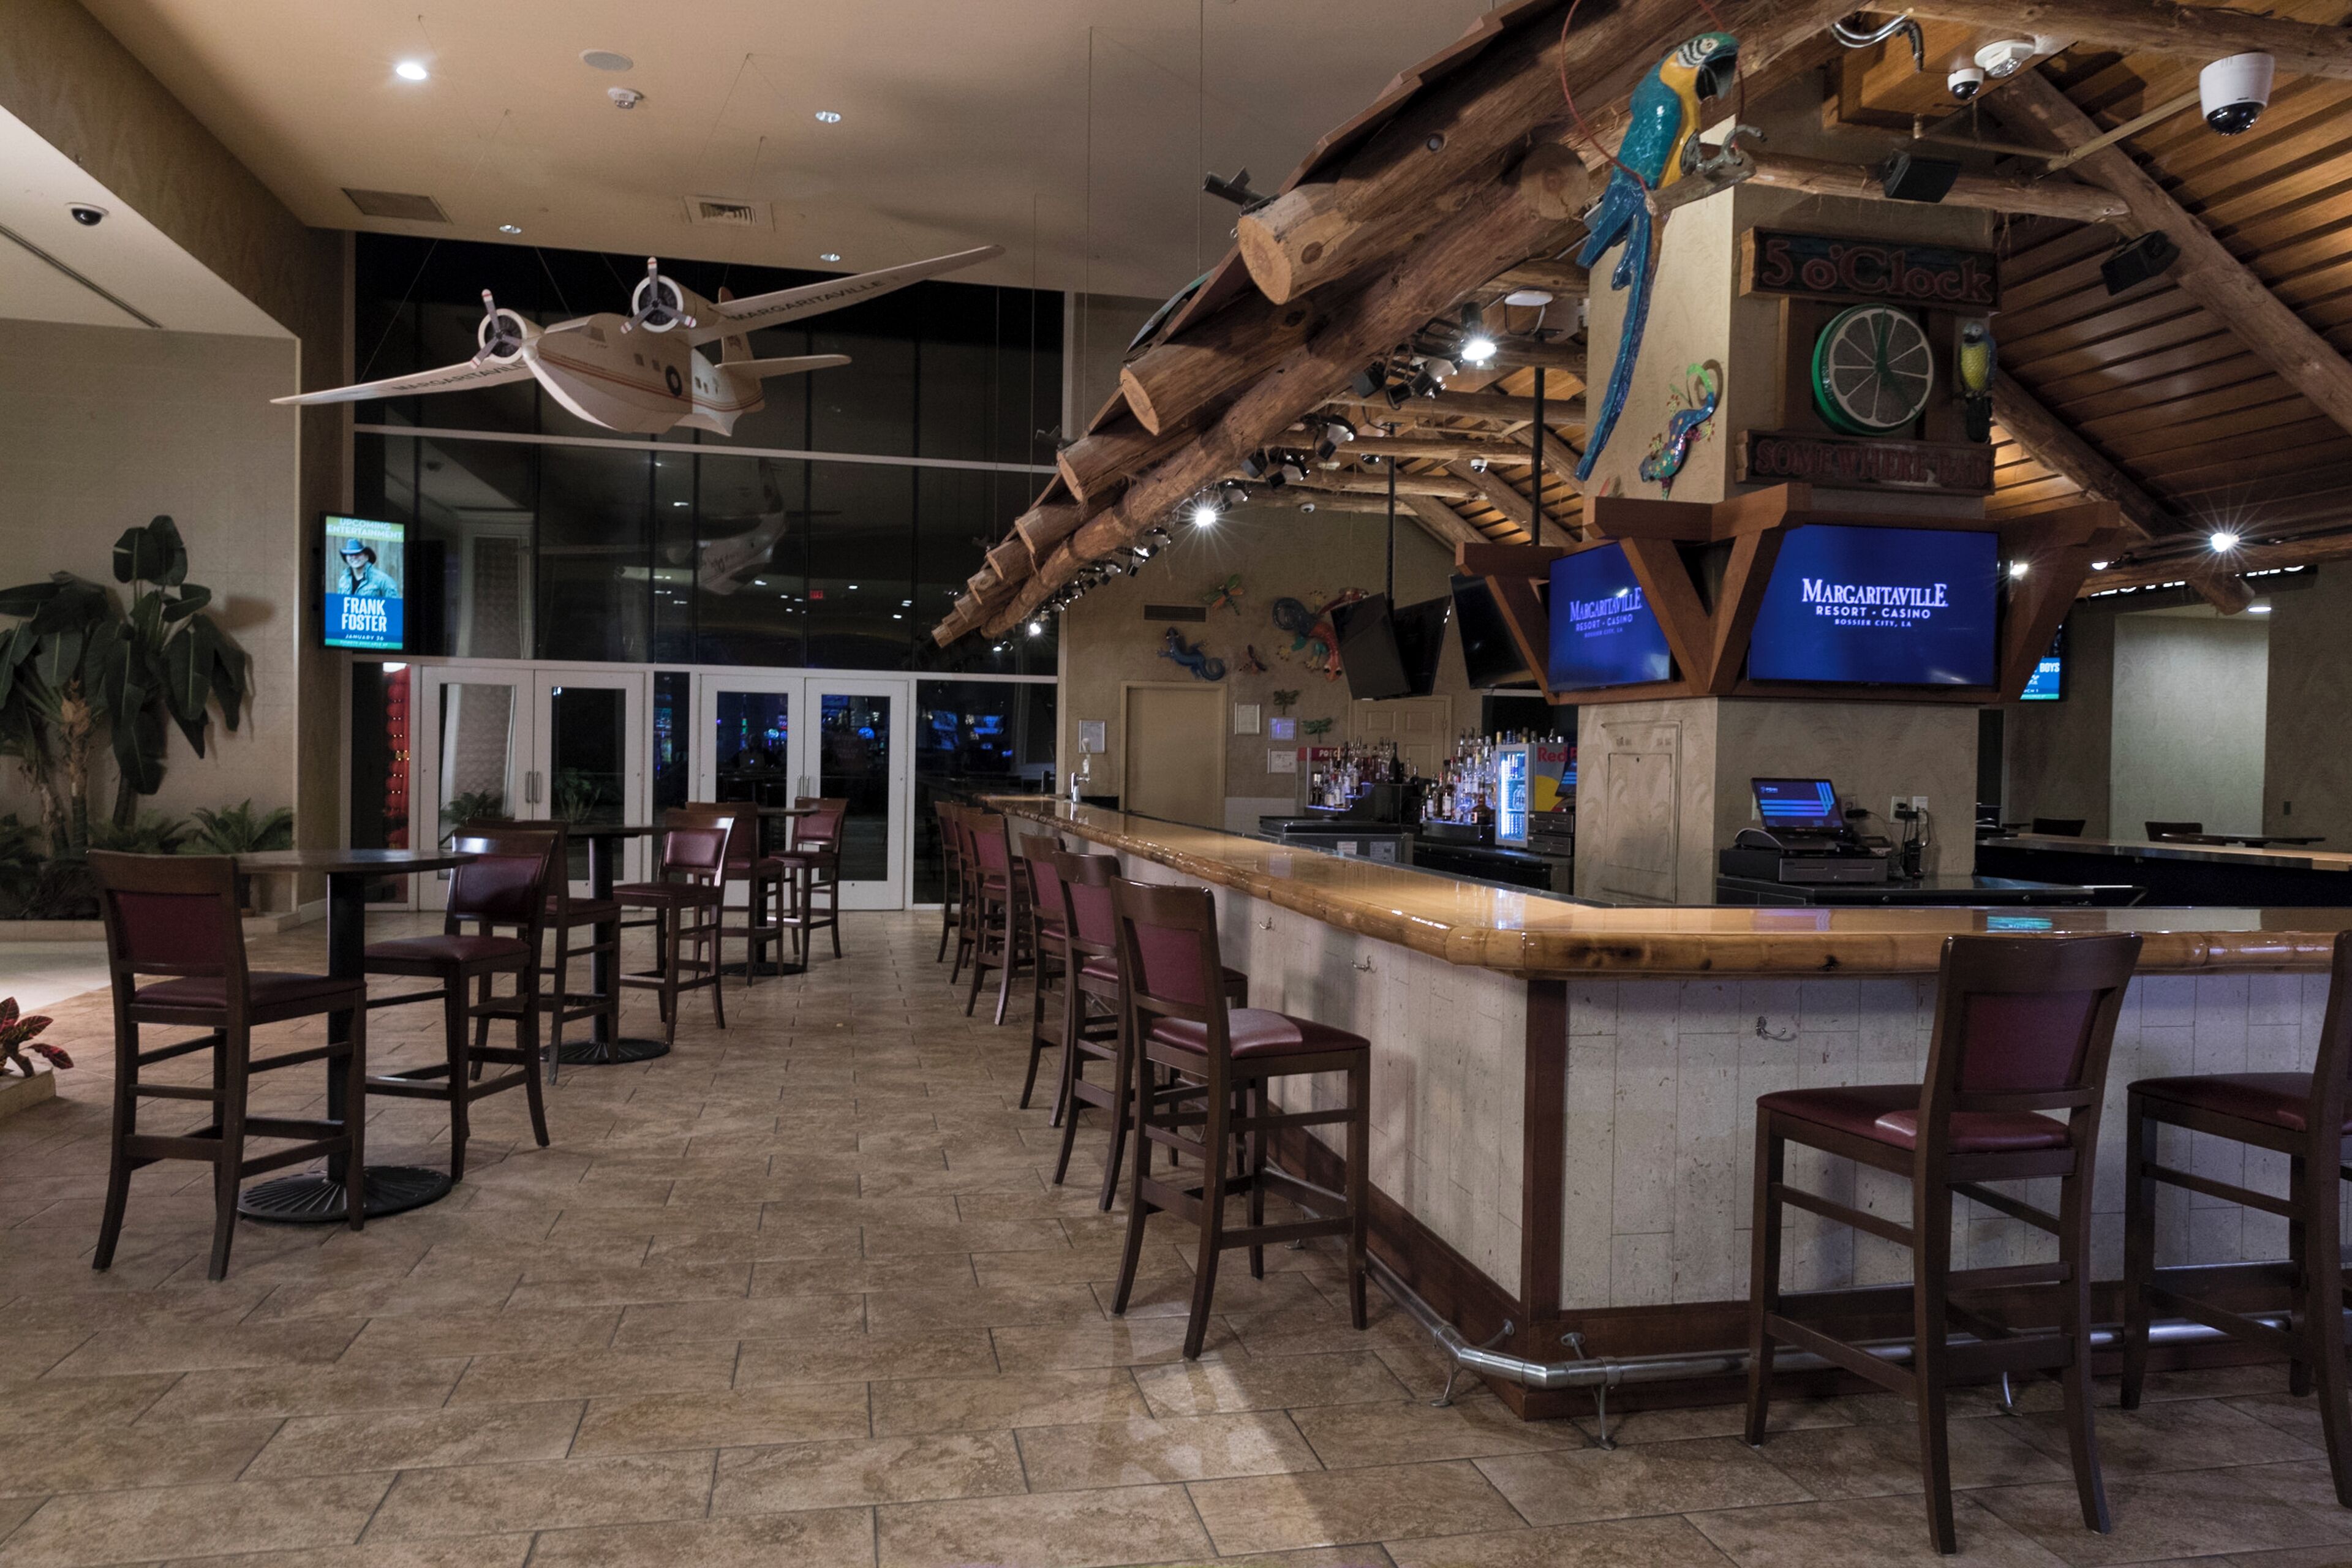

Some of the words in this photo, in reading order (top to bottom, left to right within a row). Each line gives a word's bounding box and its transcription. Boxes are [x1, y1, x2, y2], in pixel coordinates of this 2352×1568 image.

[1762, 239, 1794, 287] 5
[1801, 244, 1994, 304] o'Clock
[731, 280, 886, 321] MARGARITAVILLE
[393, 362, 529, 391] MARGARITAVILL
[1755, 438, 1928, 483] SOMEWHERE
[326, 524, 403, 539] ENTERTAINMENT
[339, 517, 392, 530] UPCOMING
[1802, 578, 1949, 608] MARGARITAVILLE
[343, 597, 386, 616] FRANK
[1569, 586, 1643, 622] MARGARITAVILLE
[1815, 605, 1868, 617] RESORT
[1881, 607, 1931, 619] CASINO
[341, 613, 387, 633] FOSTER
[1575, 619, 1601, 632] RESORT
[1607, 613, 1633, 627] CASINO
[1874, 619, 1898, 628] CITY,
[2039, 662, 2060, 673] BOYS
[1537, 746, 1568, 763] Red
